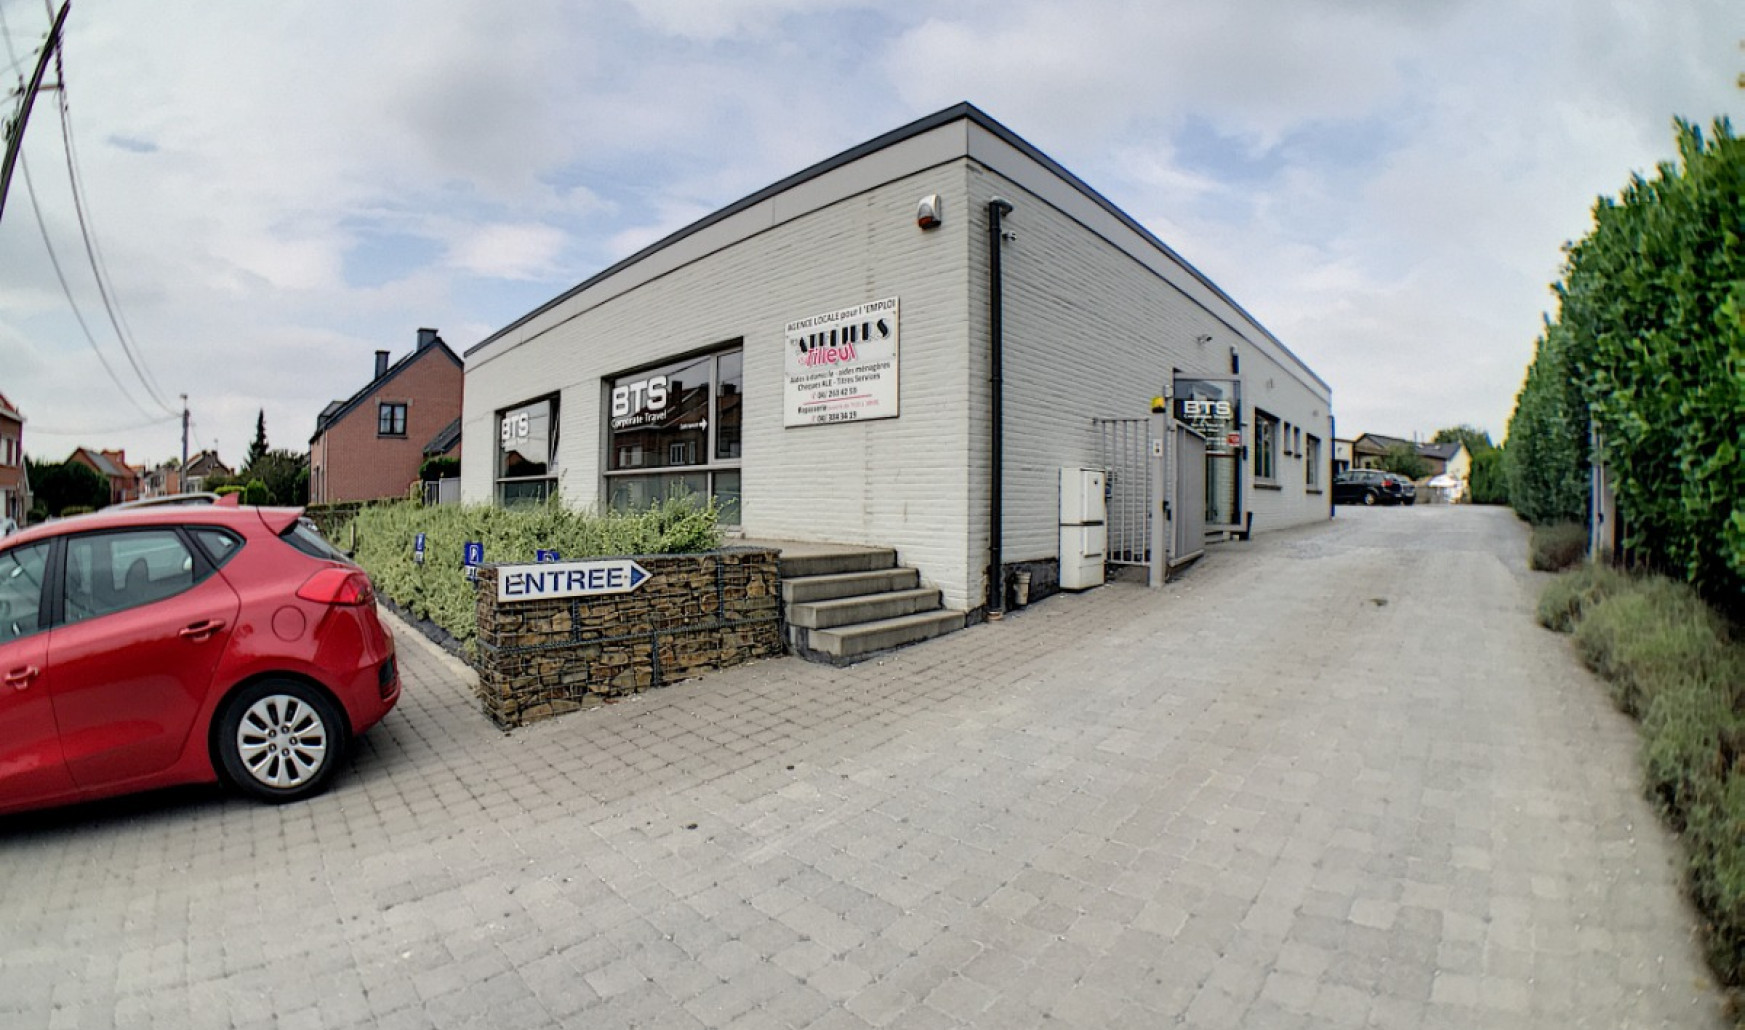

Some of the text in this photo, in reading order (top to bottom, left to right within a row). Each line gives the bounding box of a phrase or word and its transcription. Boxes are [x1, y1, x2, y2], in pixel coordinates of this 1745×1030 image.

[814, 312, 839, 325] LOCALE
[840, 309, 858, 320] pour
[855, 372, 881, 383] Services
[612, 376, 667, 417] BTS
[1184, 400, 1231, 415] BTS
[501, 412, 529, 440] BTS
[611, 409, 667, 429] Corporate Travel
[505, 567, 624, 596] ENTREE
